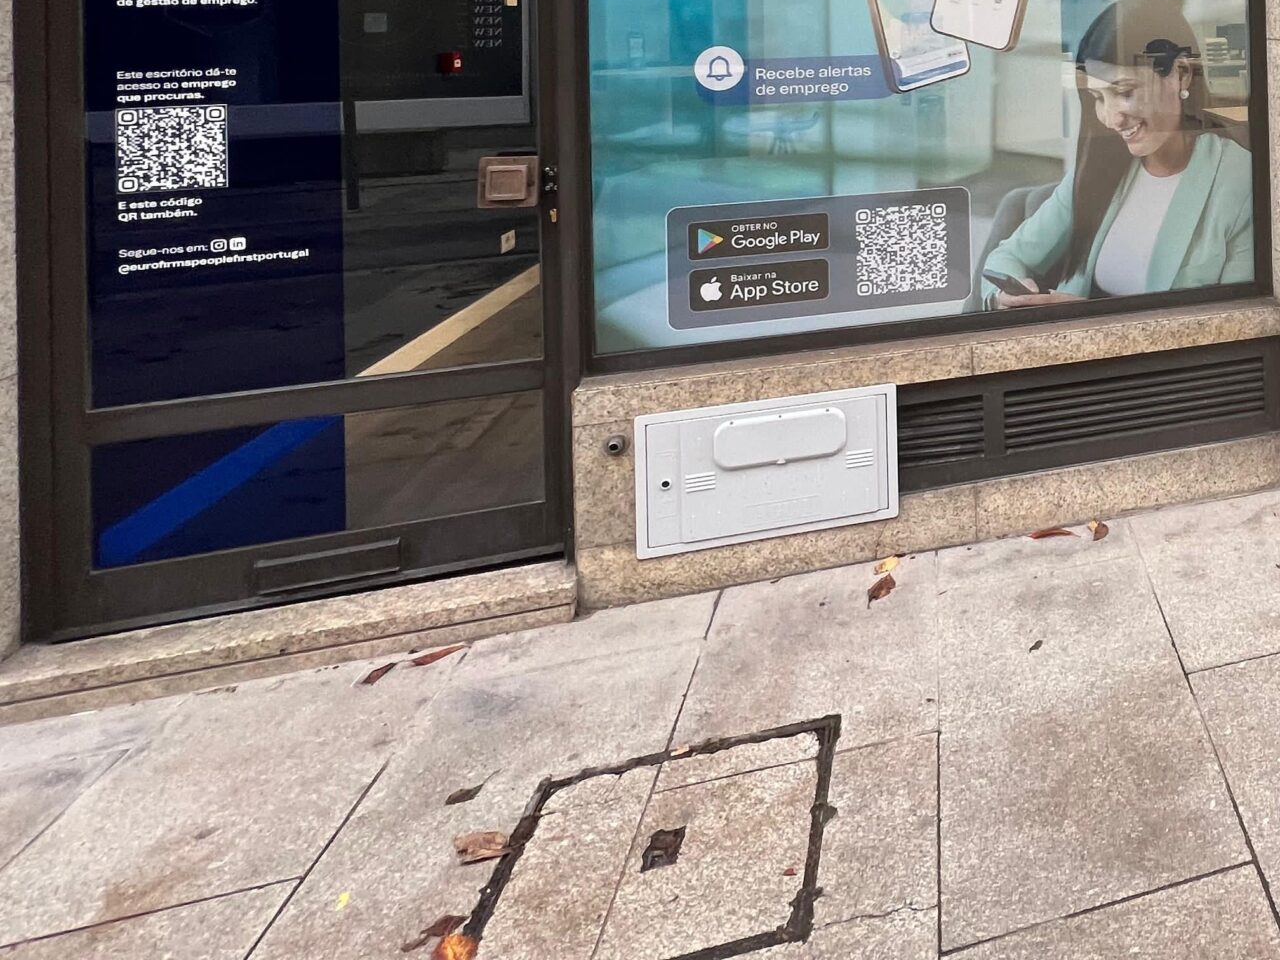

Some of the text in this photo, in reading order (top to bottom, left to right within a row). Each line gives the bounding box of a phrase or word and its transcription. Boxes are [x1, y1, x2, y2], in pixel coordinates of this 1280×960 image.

[116, 68, 236, 79] Este escritório dá-te
[756, 66, 871, 80] Recebe alertas
[181, 80, 236, 89] emprego
[756, 83, 848, 96] de emprego
[117, 92, 205, 103] que procuras.
[118, 197, 203, 210] E este código
[118, 209, 198, 222] QR também.
[731, 222, 777, 232] OBTER NO
[731, 230, 820, 249] Google Play
[118, 246, 184, 259] Segue-nos
[186, 244, 208, 253] em:
[731, 273, 761, 282] Baixar
[730, 280, 819, 301] App Store
